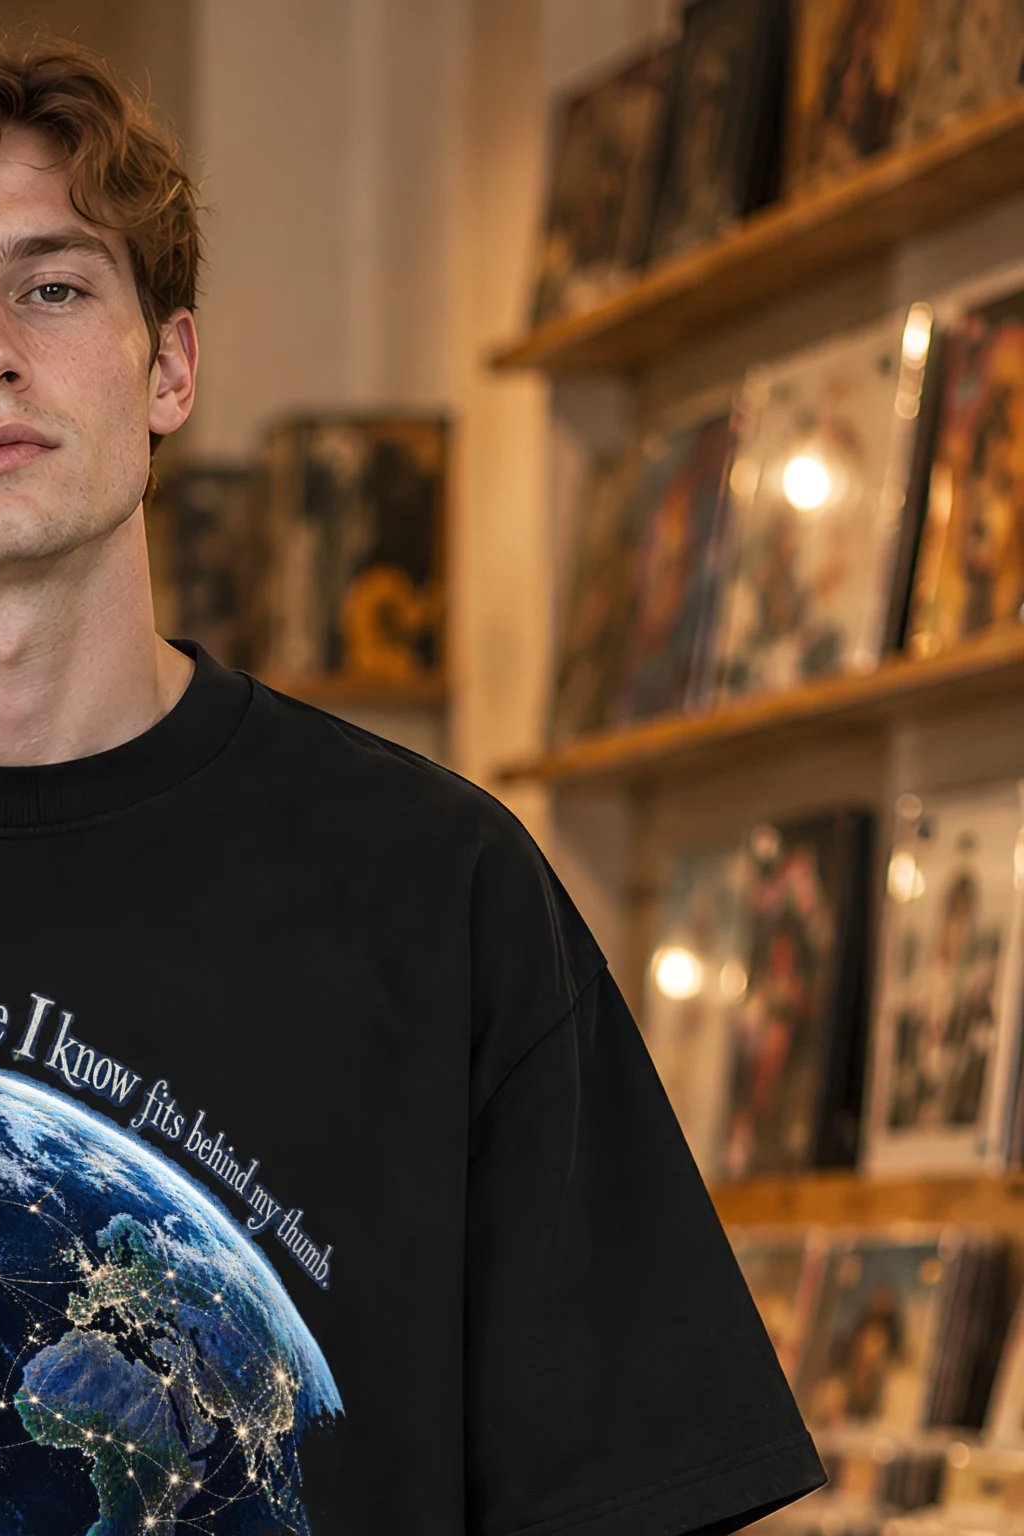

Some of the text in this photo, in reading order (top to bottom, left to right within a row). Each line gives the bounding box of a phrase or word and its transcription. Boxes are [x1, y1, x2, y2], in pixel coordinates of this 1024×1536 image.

[13, 992, 56, 1061] I
[44, 1011, 142, 1104] know
[131, 1079, 185, 1140] fits
[184, 1109, 261, 1195] behind
[247, 1183, 282, 1230] my
[276, 1207, 334, 1288] thumb.
